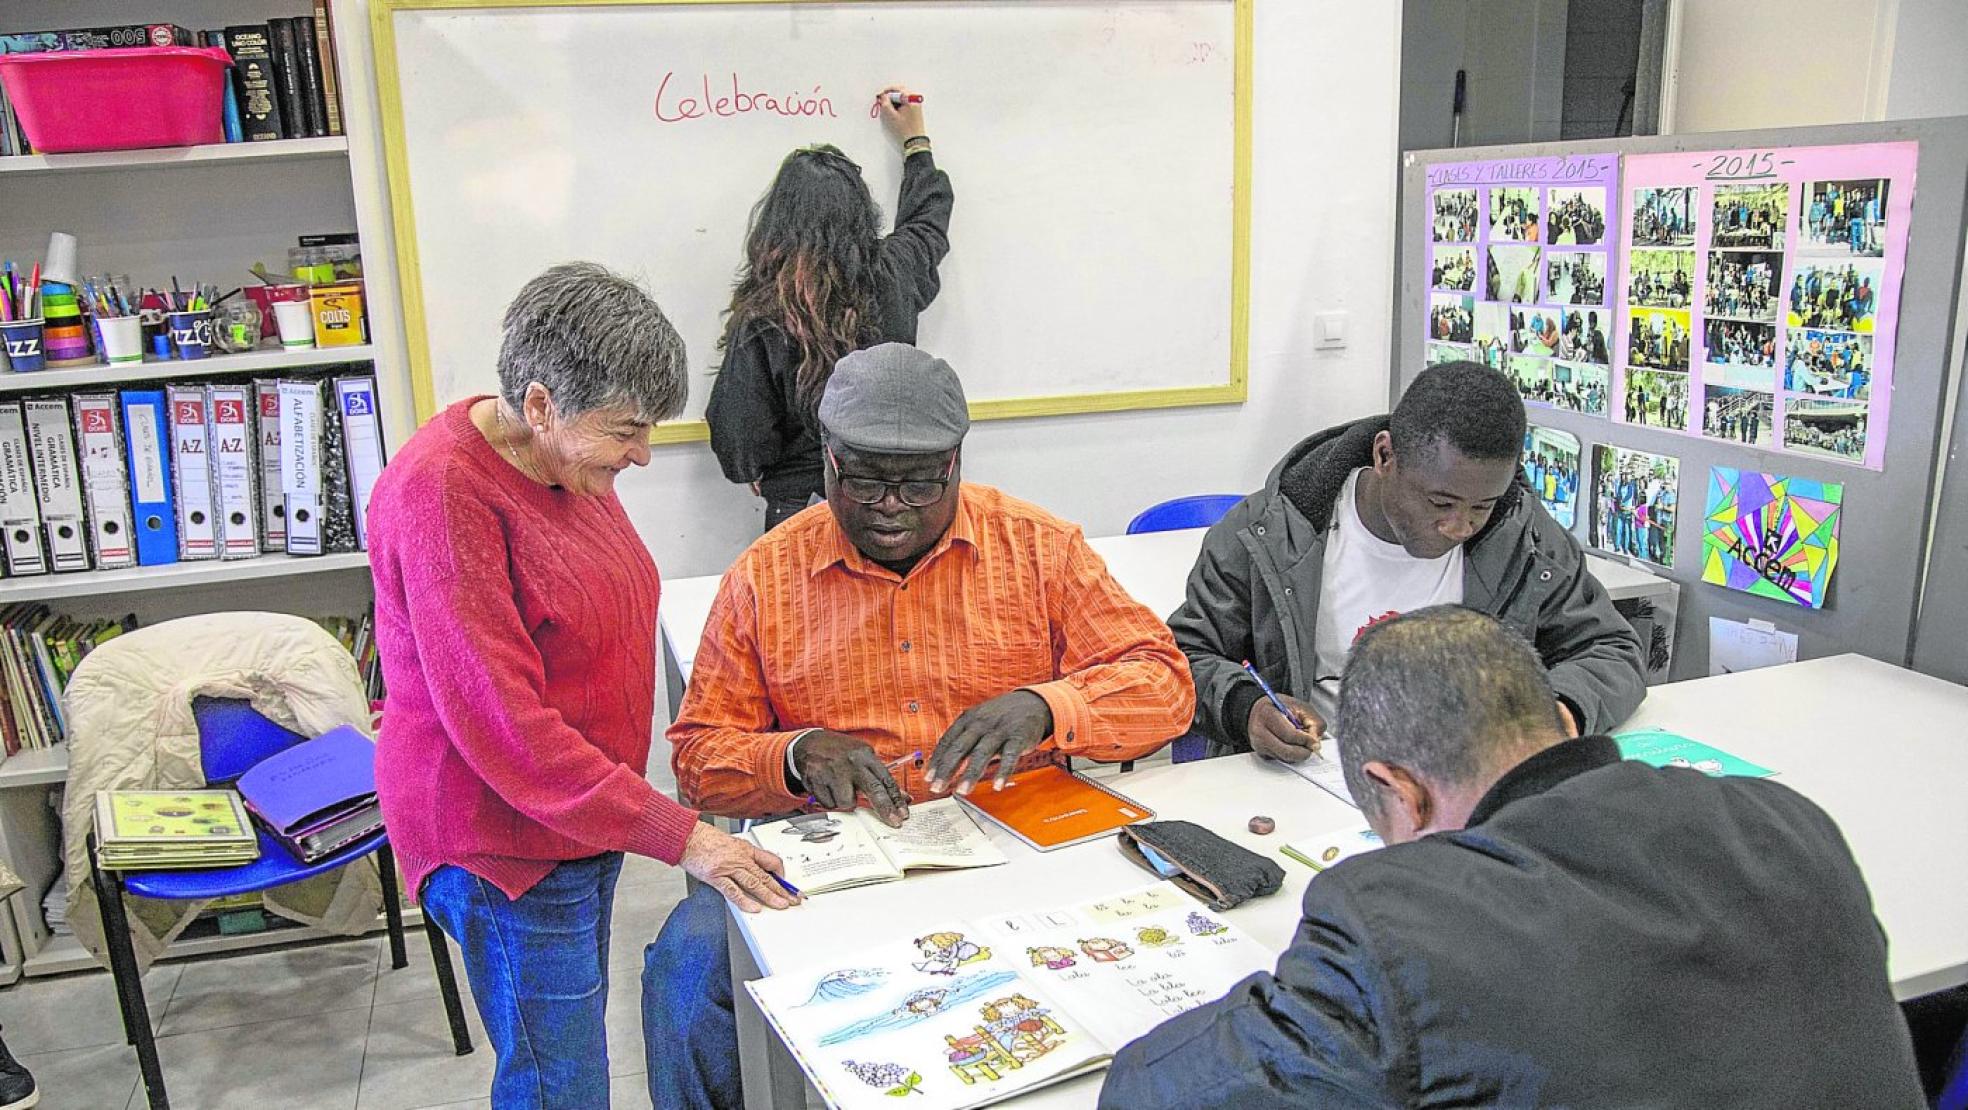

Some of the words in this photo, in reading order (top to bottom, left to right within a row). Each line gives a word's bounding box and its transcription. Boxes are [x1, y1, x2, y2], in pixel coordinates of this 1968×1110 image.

[110, 27, 147, 46] 500
[655, 71, 838, 122] Celebración
[320, 309, 351, 324] COLTS
[32, 422, 42, 448] NIVEL
[181, 439, 204, 454] A-Z
[221, 437, 244, 452] A-Z
[292, 398, 306, 489] ALFABETIZACIÓN
[2, 441, 18, 493] GRAMÁTICA
[47, 436, 61, 488] GRAMÁTICA
